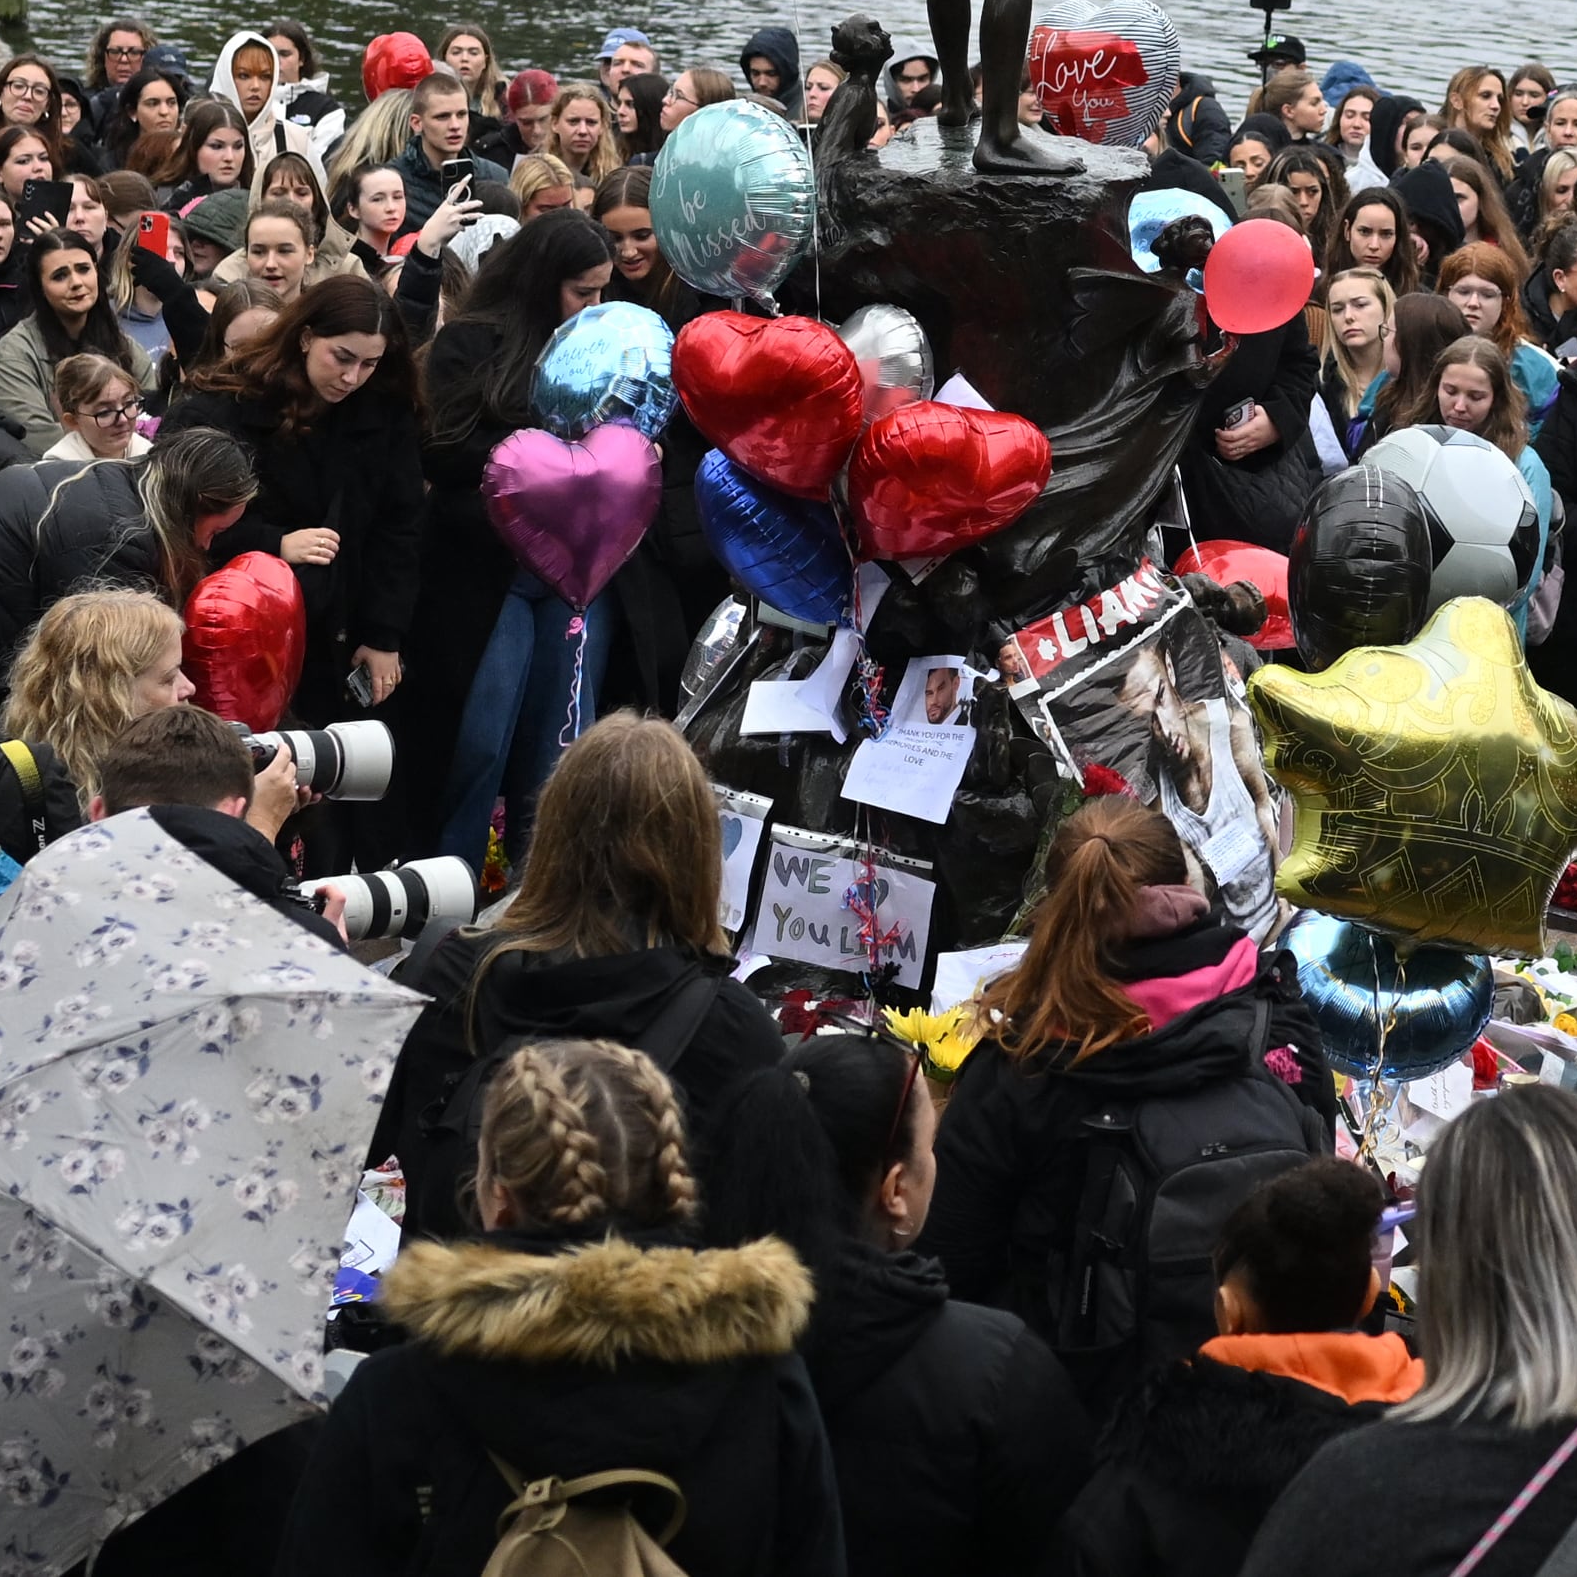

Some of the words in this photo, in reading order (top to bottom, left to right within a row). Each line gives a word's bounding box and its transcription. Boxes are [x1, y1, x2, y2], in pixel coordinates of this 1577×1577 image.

[1031, 33, 1045, 61] I
[1036, 31, 1117, 105] Love
[1072, 88, 1115, 121] You
[678, 179, 707, 225] be
[667, 191, 767, 271] Missed
[1053, 570, 1162, 658] LIAM
[903, 754, 925, 766] LOVE
[773, 851, 837, 894] WE
[840, 926, 917, 963] LM
